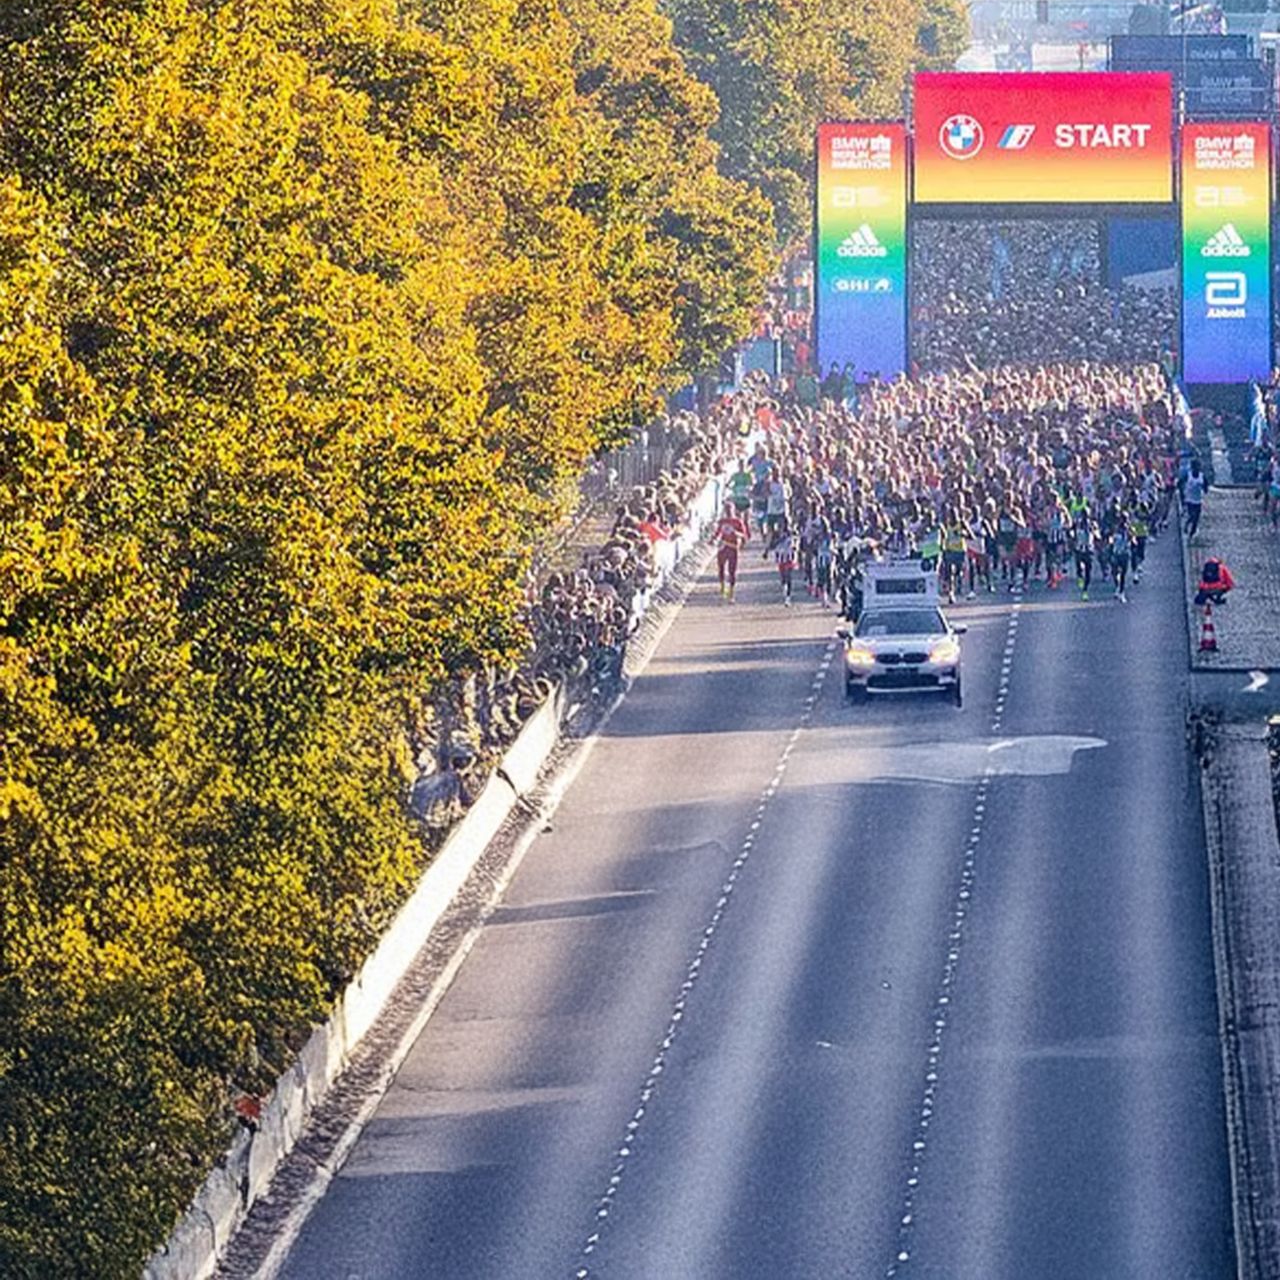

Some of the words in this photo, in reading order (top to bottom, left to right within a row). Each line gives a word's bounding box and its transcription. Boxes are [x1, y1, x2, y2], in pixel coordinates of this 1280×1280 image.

[1055, 124, 1152, 147] START
[832, 137, 869, 150] BMW
[1195, 136, 1234, 150] BMW
[832, 159, 891, 169] MARATHON
[1195, 159, 1254, 169] MARATHON
[837, 245, 888, 257] adidas
[1200, 245, 1251, 257] adidas
[1206, 307, 1247, 318] Abbott
